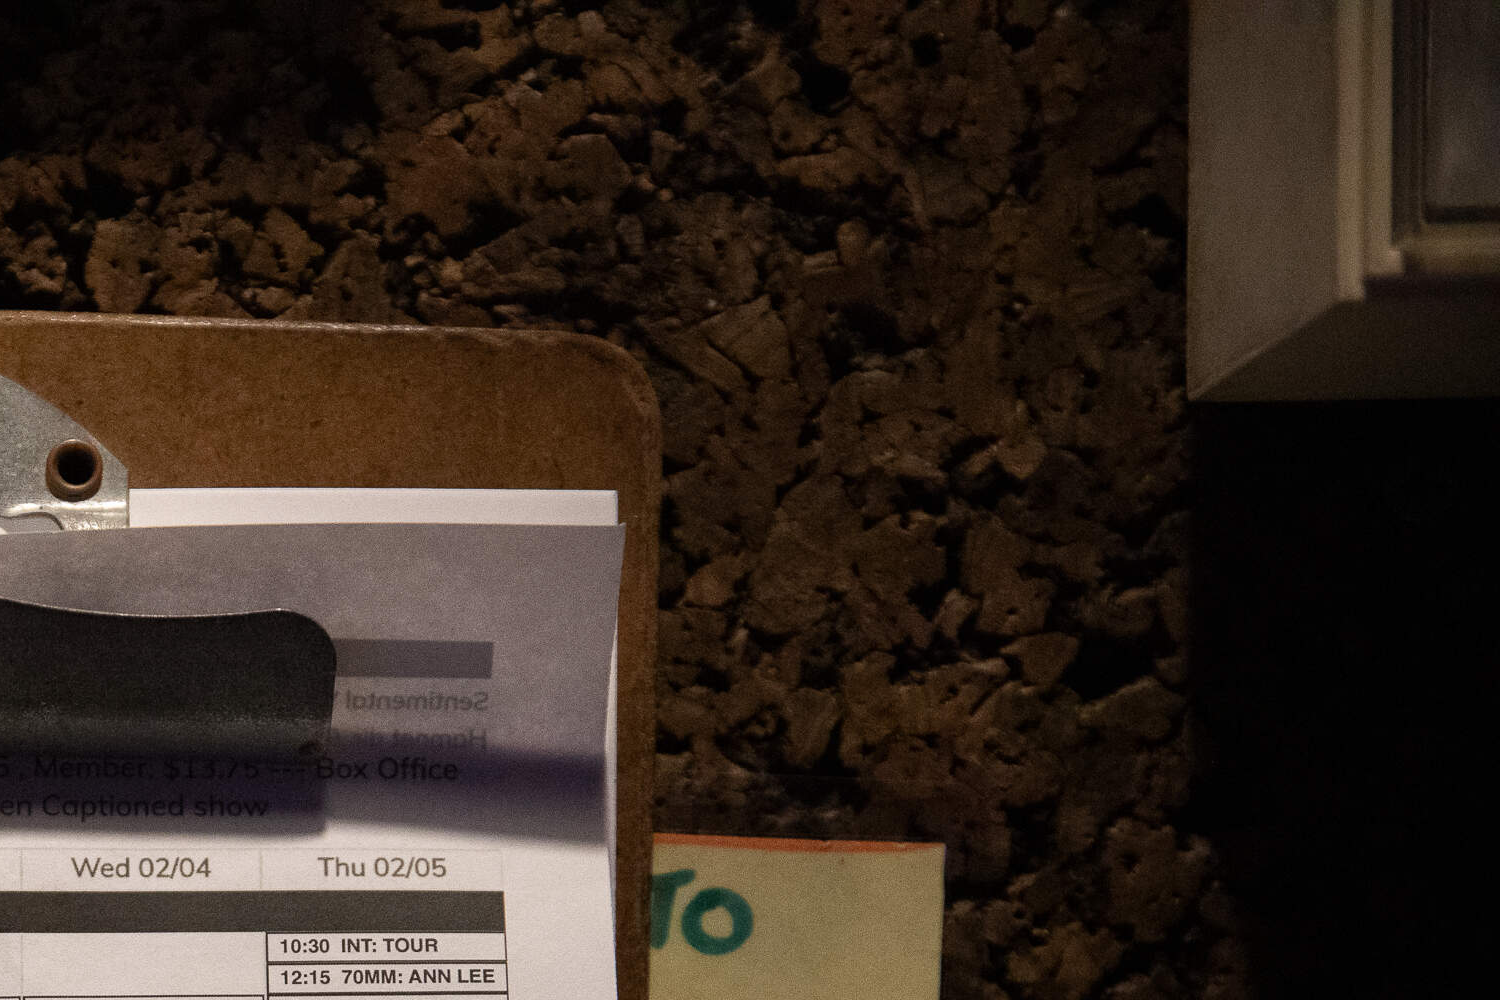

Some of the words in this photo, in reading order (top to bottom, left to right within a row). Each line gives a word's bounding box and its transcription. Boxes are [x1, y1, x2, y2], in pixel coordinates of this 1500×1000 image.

[316, 758, 367, 779] Box
[378, 757, 458, 779] Office
[42, 795, 184, 821] Captioned
[195, 795, 268, 816] show
[71, 858, 130, 878] Wed
[139, 858, 211, 878] 02/04
[318, 857, 365, 877] Thu
[374, 857, 447, 878] 02/05
[280, 939, 330, 953] 10:30
[341, 939, 376, 953] INT:
[383, 939, 438, 953] TOUR
